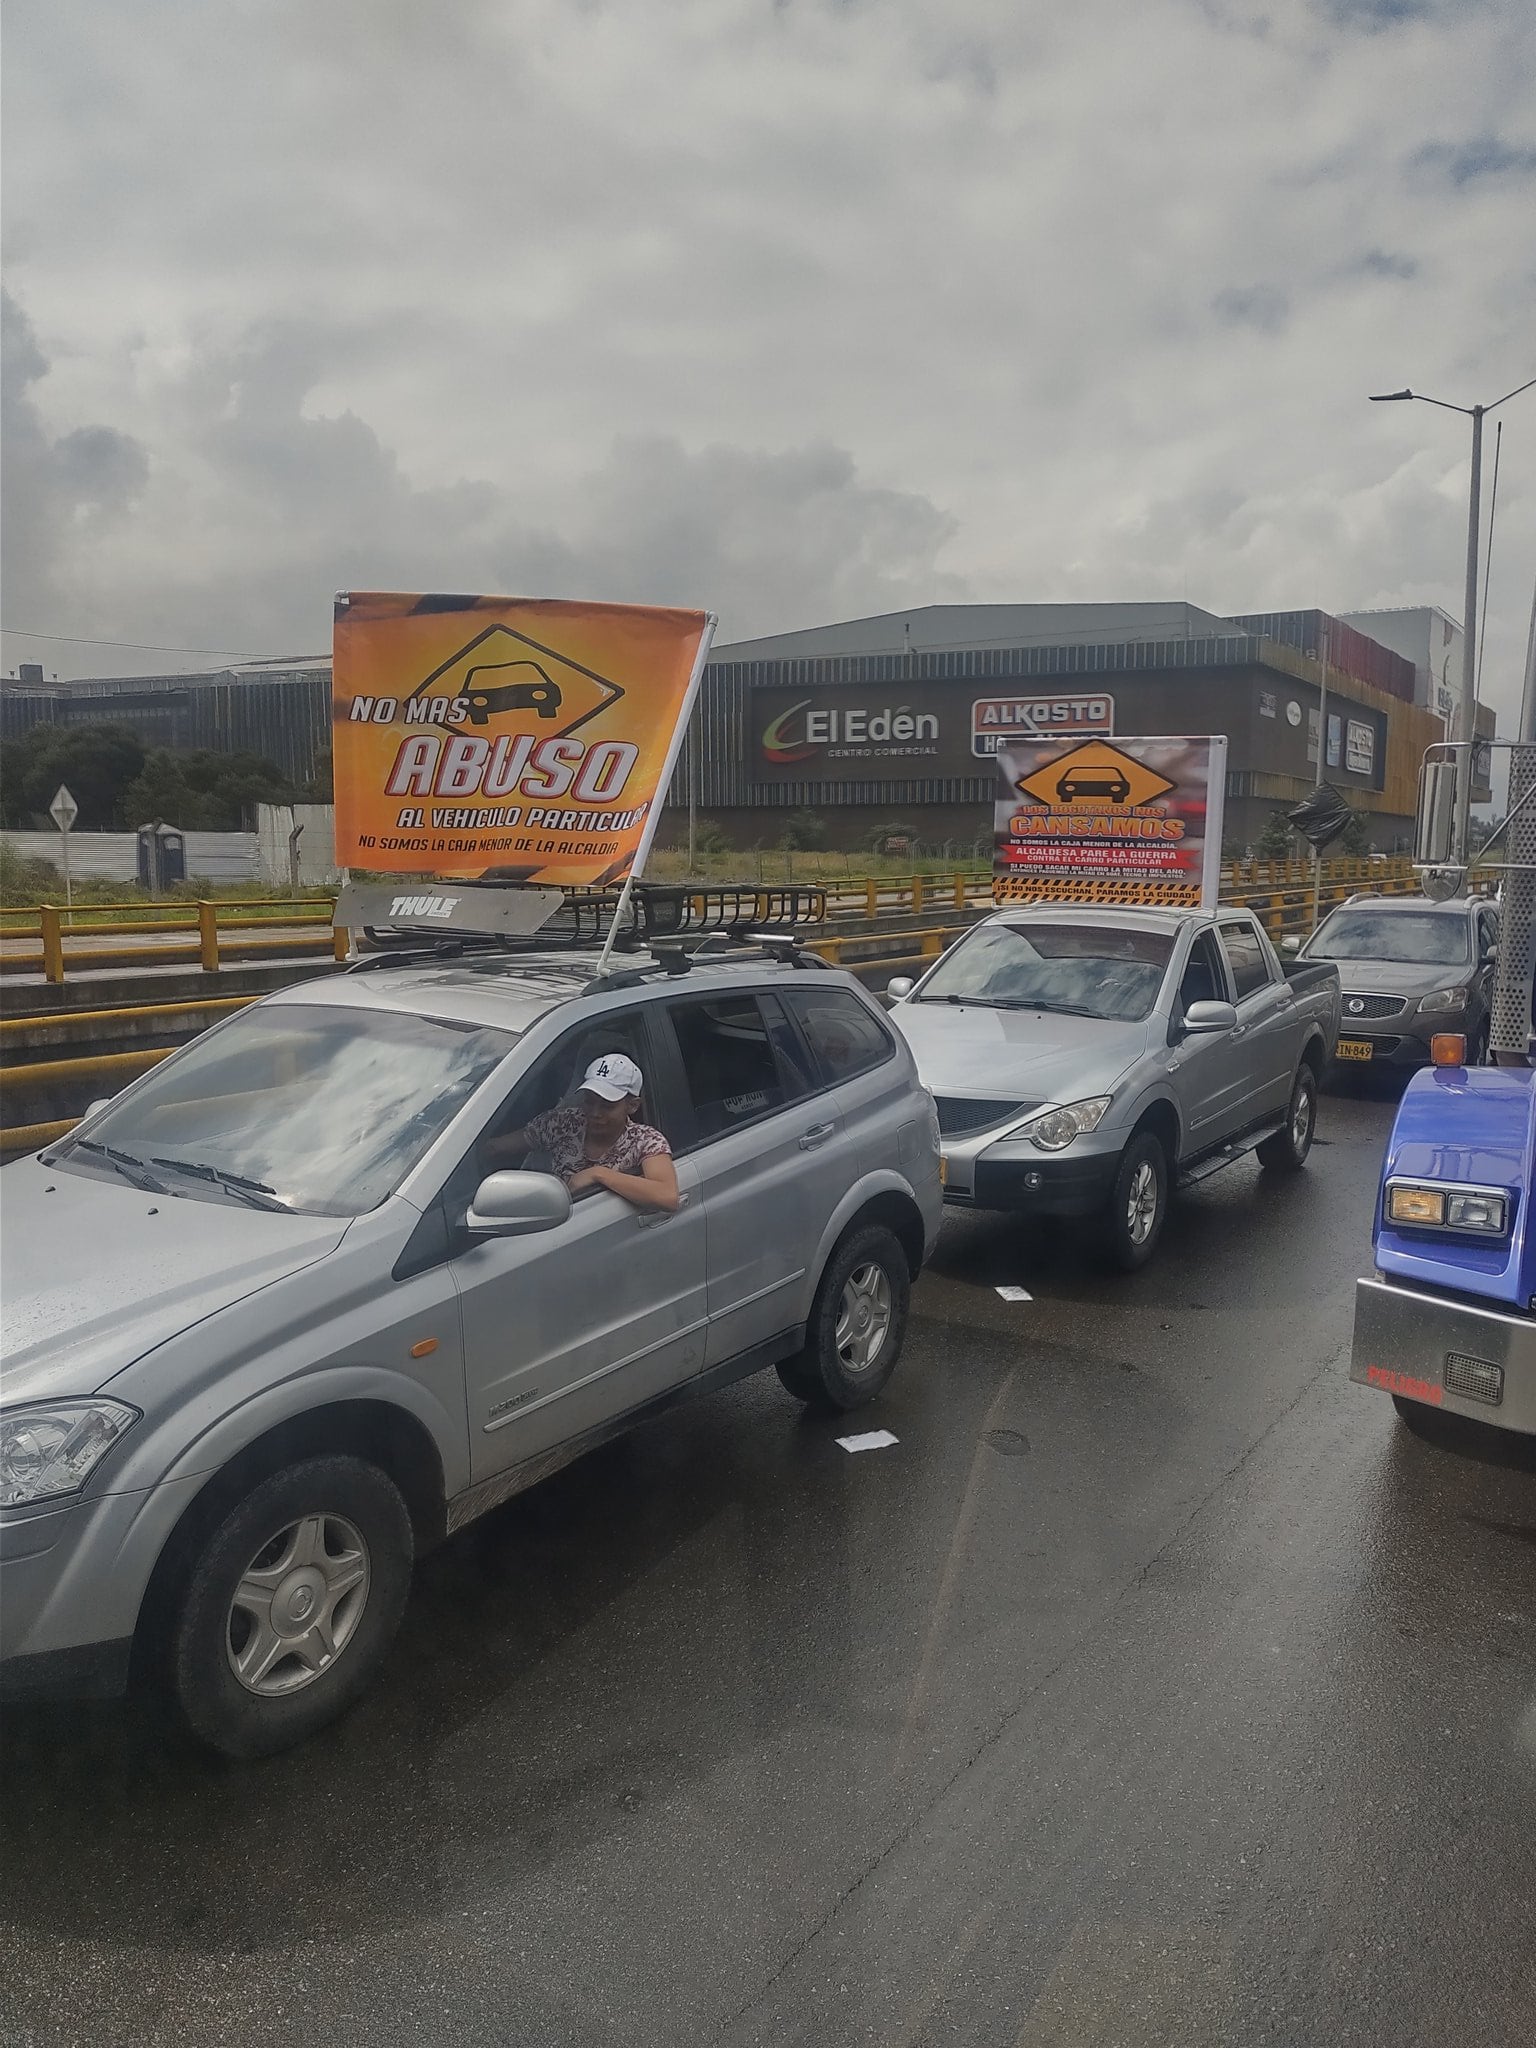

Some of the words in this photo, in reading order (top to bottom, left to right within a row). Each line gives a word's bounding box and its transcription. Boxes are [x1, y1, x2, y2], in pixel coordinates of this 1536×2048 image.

[349, 695, 398, 724] NO
[404, 696, 470, 724] MAS
[982, 701, 1106, 732] ALKOSTO
[807, 709, 838, 743] El
[845, 704, 939, 742] Edén
[828, 748, 872, 757] CENTRO
[874, 746, 939, 756] COMERCIAL
[384, 734, 640, 804] ABUSO
[397, 808, 425, 828] AL
[431, 806, 522, 829] VEHICULO
[1022, 805, 1049, 815] LOS
[1133, 807, 1166, 817] NOS
[1010, 816, 1185, 840] CANSAMOS
[358, 834, 376, 848] NO
[379, 838, 428, 851] SOMOS
[432, 839, 445, 851] LA
[448, 839, 477, 852] CAJA
[479, 838, 512, 851] MENOR
[515, 839, 534, 851] DE
[536, 840, 554, 853] LA
[557, 842, 618, 855] ALCALDIA
[1016, 848, 1077, 856] ALCALDESA
[1080, 849, 1109, 858] PARE
[1112, 850, 1127, 858] LA
[1130, 851, 1177, 859] GUERRA
[1106, 858, 1162, 866] PARTICULAR
[1096, 889, 1141, 897] PARAMOS
[1157, 891, 1195, 899] CIUDAD!
[389, 896, 462, 918] THULE
[1367, 1365, 1442, 1404] PELIGRO
